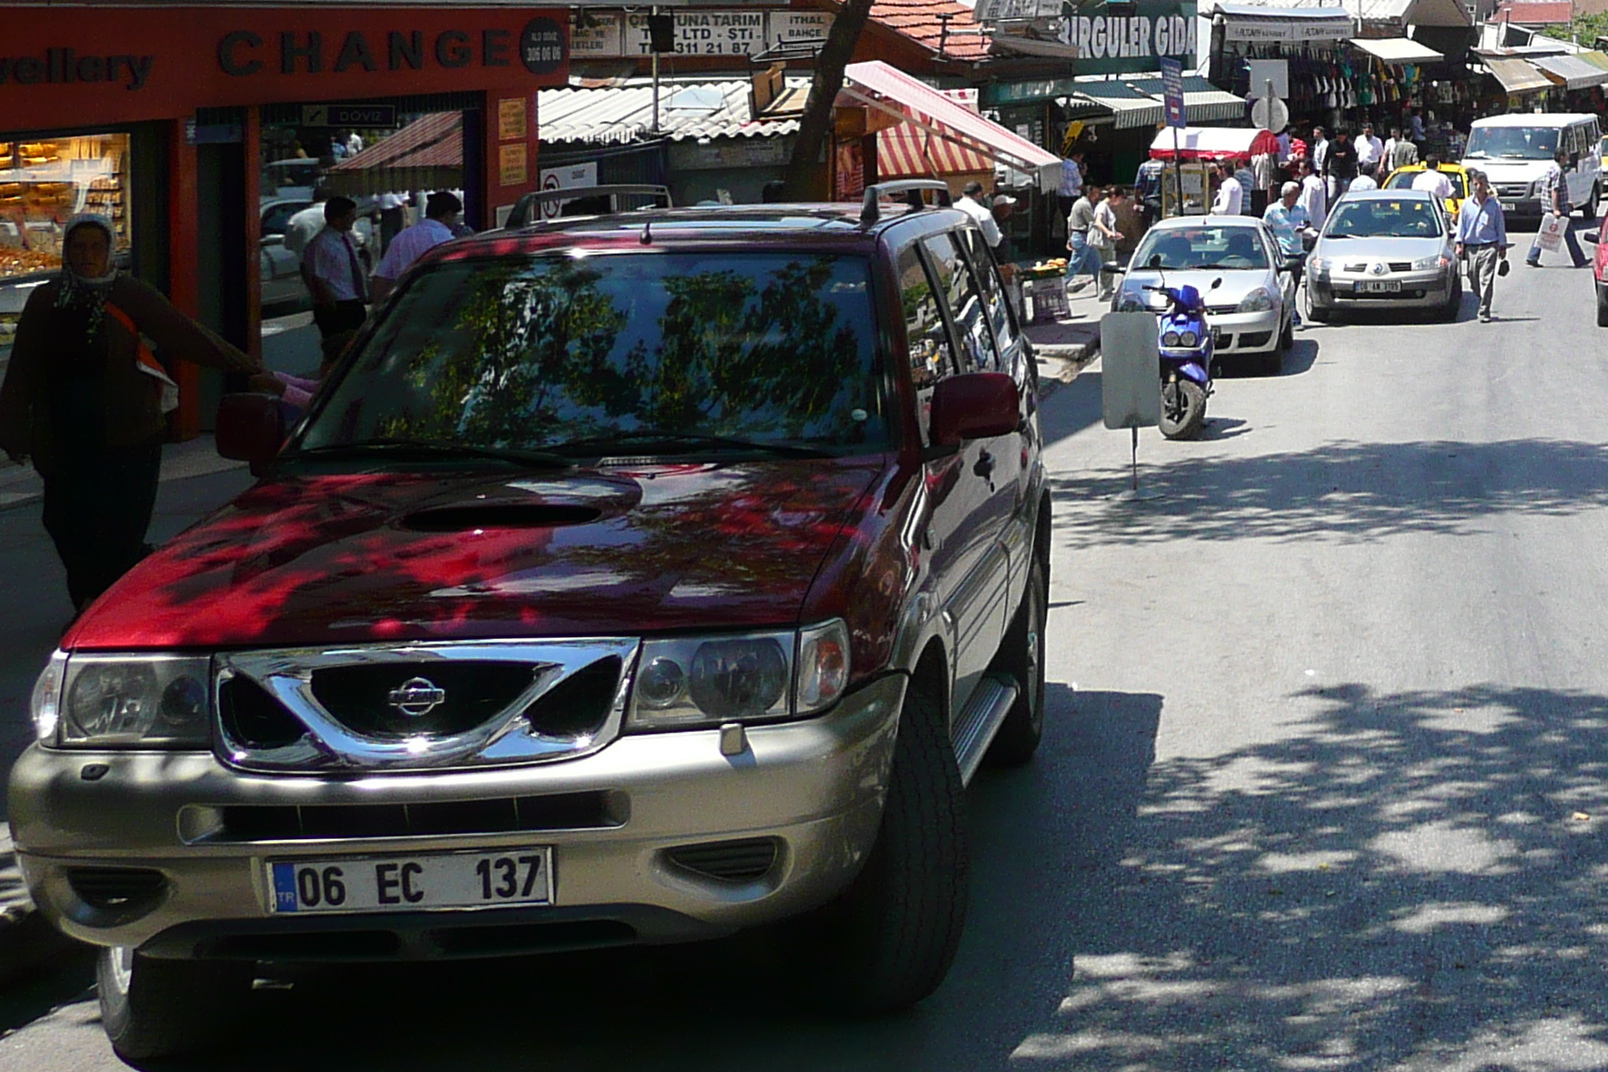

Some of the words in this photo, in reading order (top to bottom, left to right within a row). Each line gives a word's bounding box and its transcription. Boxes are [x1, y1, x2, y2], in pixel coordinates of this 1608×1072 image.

[712, 14, 761, 26] TARIM
[682, 28, 711, 40] LTD
[216, 28, 511, 77] CHANGE
[675, 42, 699, 54] 311
[706, 42, 723, 54] 21
[732, 42, 749, 54] 87
[277, 891, 295, 903] TR
[297, 866, 346, 907] 06
[375, 862, 424, 905] EC
[476, 854, 541, 900] 137
